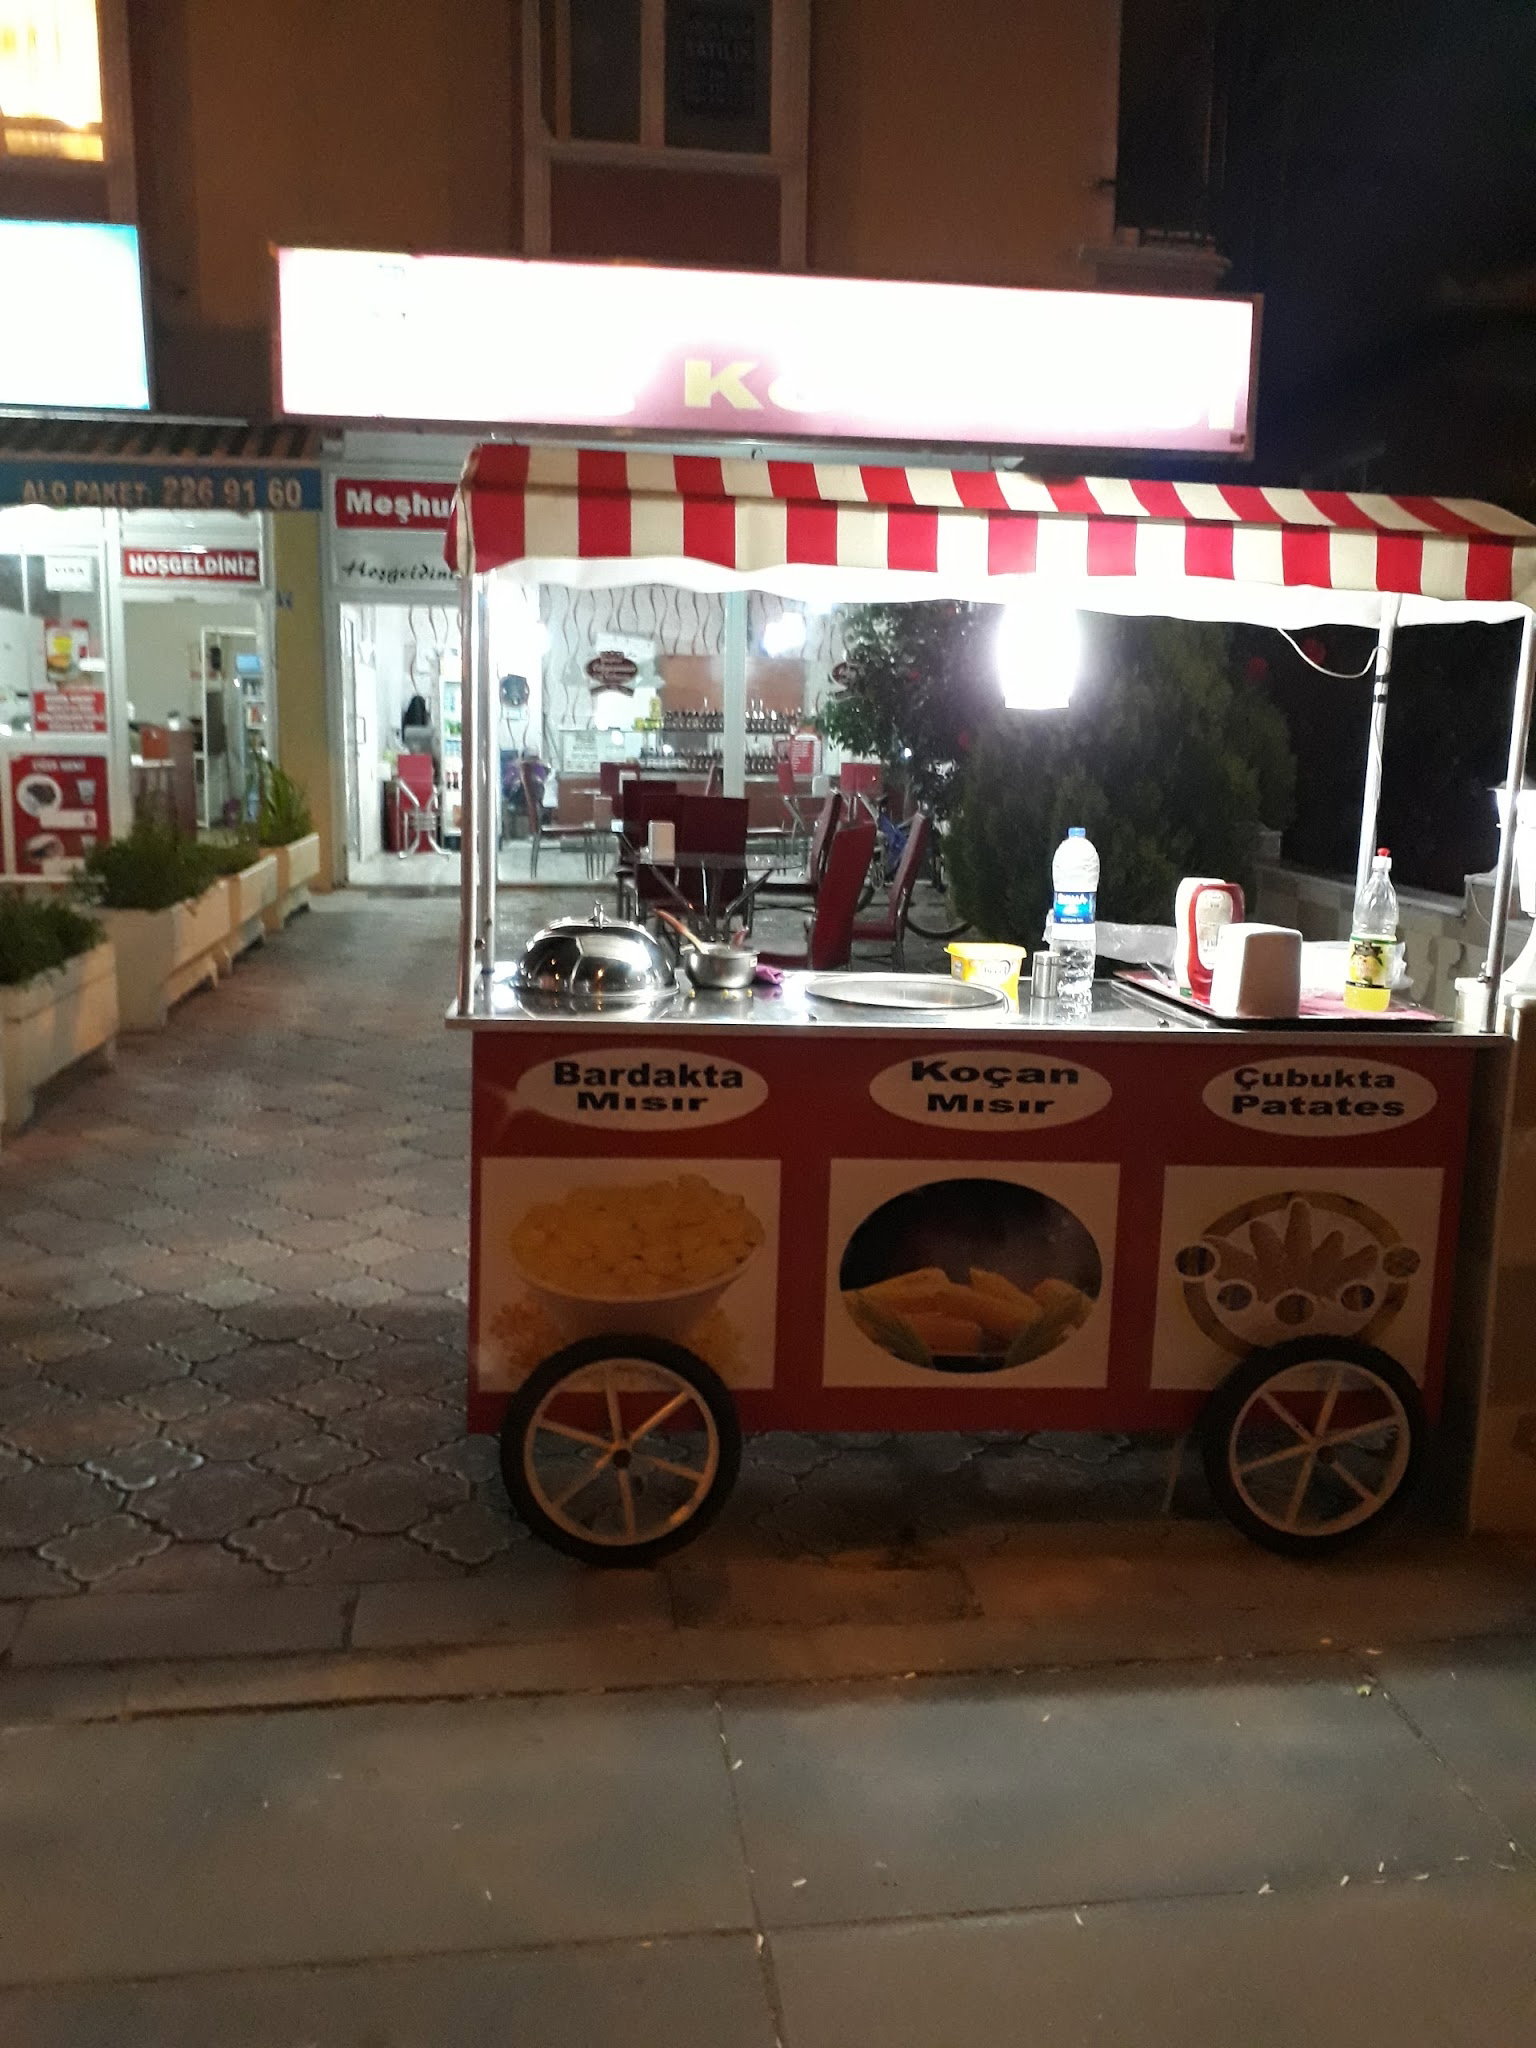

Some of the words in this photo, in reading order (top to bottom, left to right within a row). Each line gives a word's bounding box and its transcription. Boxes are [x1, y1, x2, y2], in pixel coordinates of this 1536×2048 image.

[162, 475, 214, 508] 226
[223, 477, 256, 510] 91
[268, 478, 302, 510] 60
[346, 488, 450, 524] Meşhu
[128, 553, 257, 577] HOŞGELDİNİZ
[340, 561, 455, 584] Hoşgeldini
[554, 1061, 744, 1089] Bardakta
[912, 1060, 1079, 1088] Koçan
[1233, 1067, 1396, 1091] Çubukta
[577, 1091, 709, 1112] Mısır
[927, 1093, 1055, 1114] Mısır
[1232, 1095, 1405, 1117] Patates
